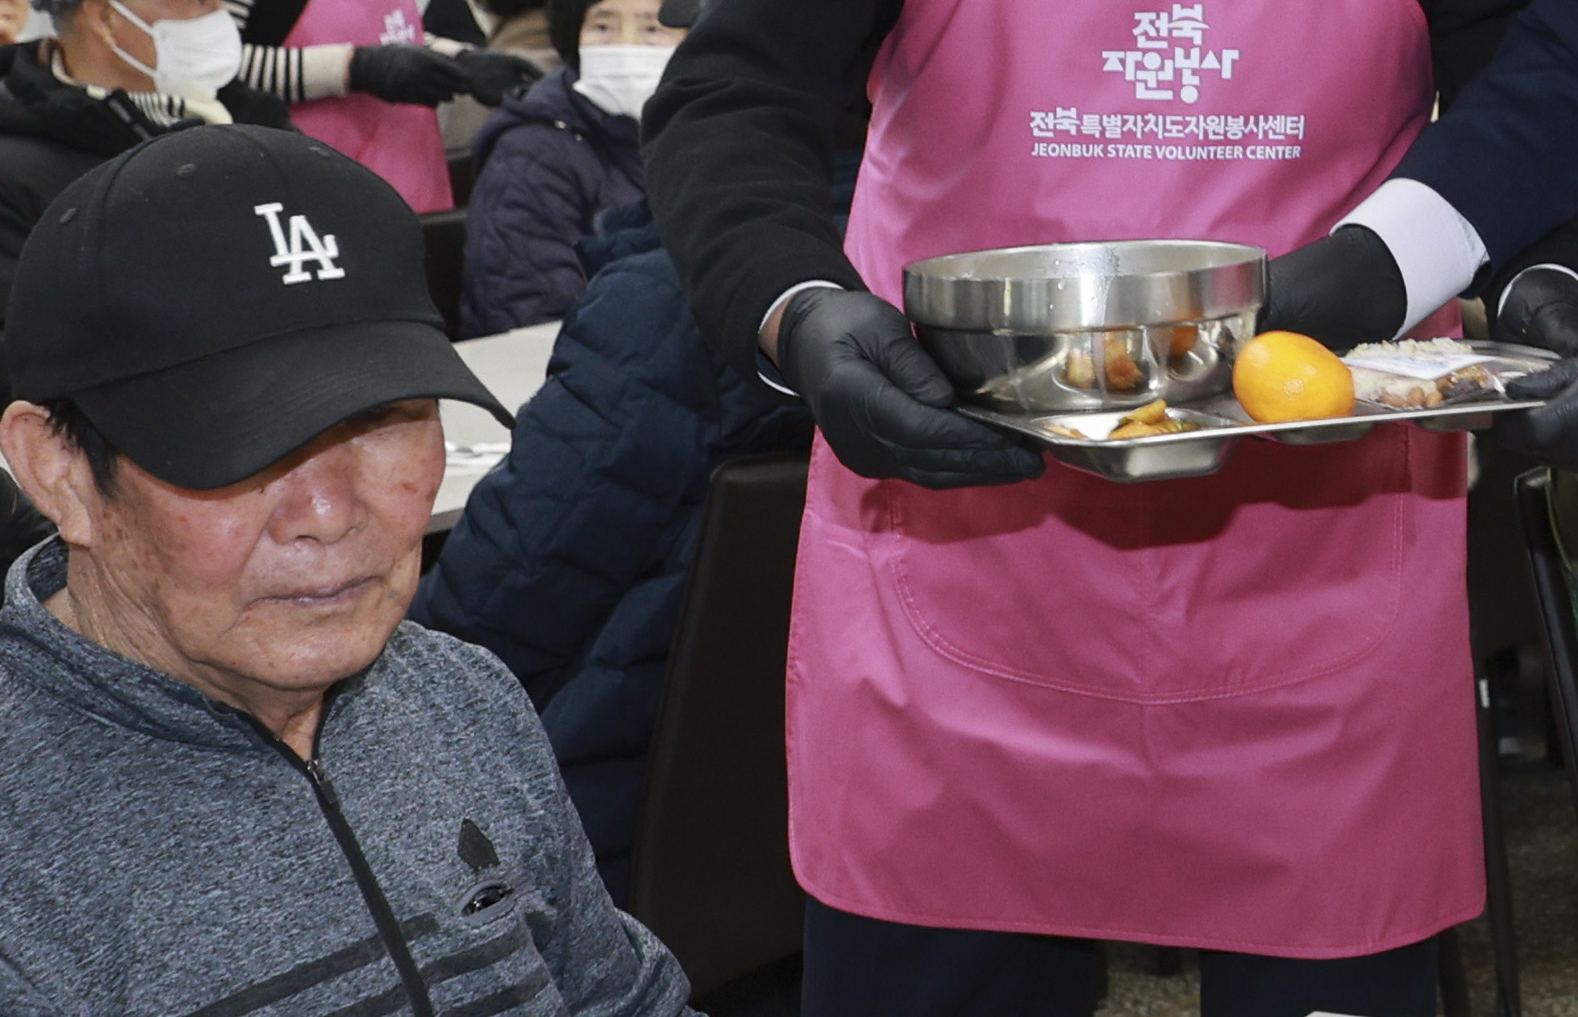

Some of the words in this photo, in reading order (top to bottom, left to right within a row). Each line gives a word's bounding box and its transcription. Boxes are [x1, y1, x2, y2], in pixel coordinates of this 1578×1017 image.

[1131, 3, 1211, 50] 전북
[1101, 45, 1241, 105] 자원봉사
[1029, 106, 1306, 141] 전북특별자치도자원봉사센터
[1031, 142, 1104, 158] JEONBUK
[1107, 143, 1153, 160] STATE
[1154, 145, 1244, 161] VOLUNTEER
[1246, 145, 1302, 160] CENTER
[253, 201, 346, 285] LA
